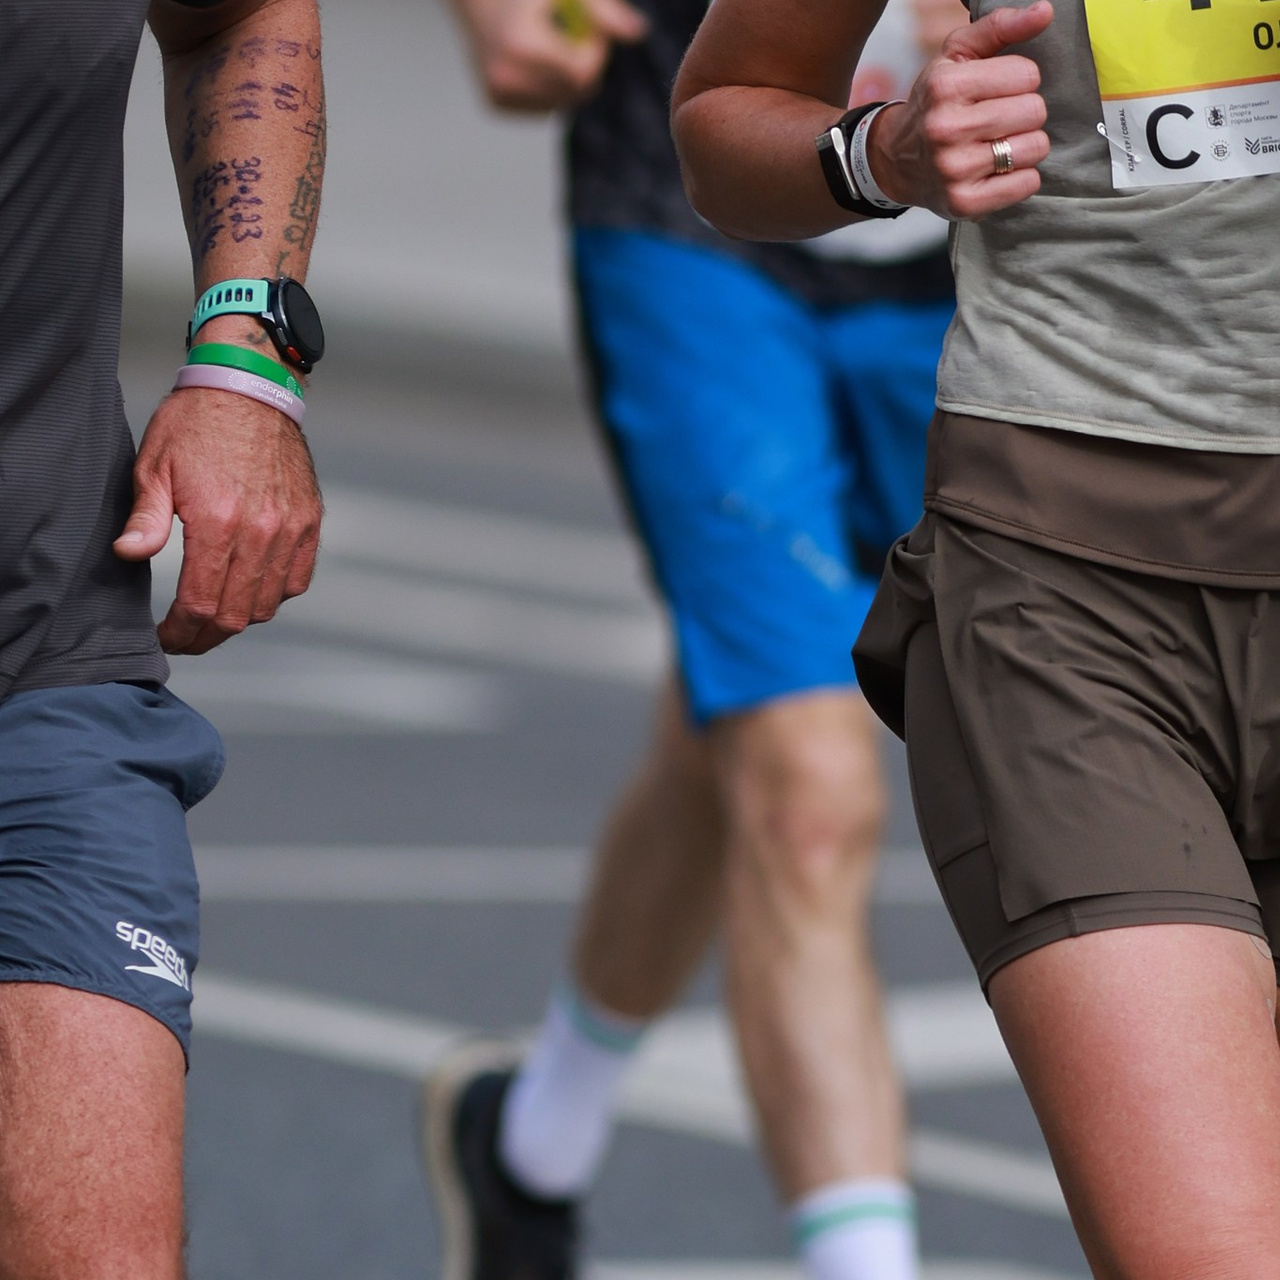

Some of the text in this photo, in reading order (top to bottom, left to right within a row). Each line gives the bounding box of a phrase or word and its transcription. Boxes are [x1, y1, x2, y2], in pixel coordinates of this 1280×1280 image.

[1229, 100, 1270, 112] Департамент
[1119, 108, 1130, 136] CORRAL
[1253, 114, 1279, 122] Москвы
[251, 379, 294, 405] endorphin
